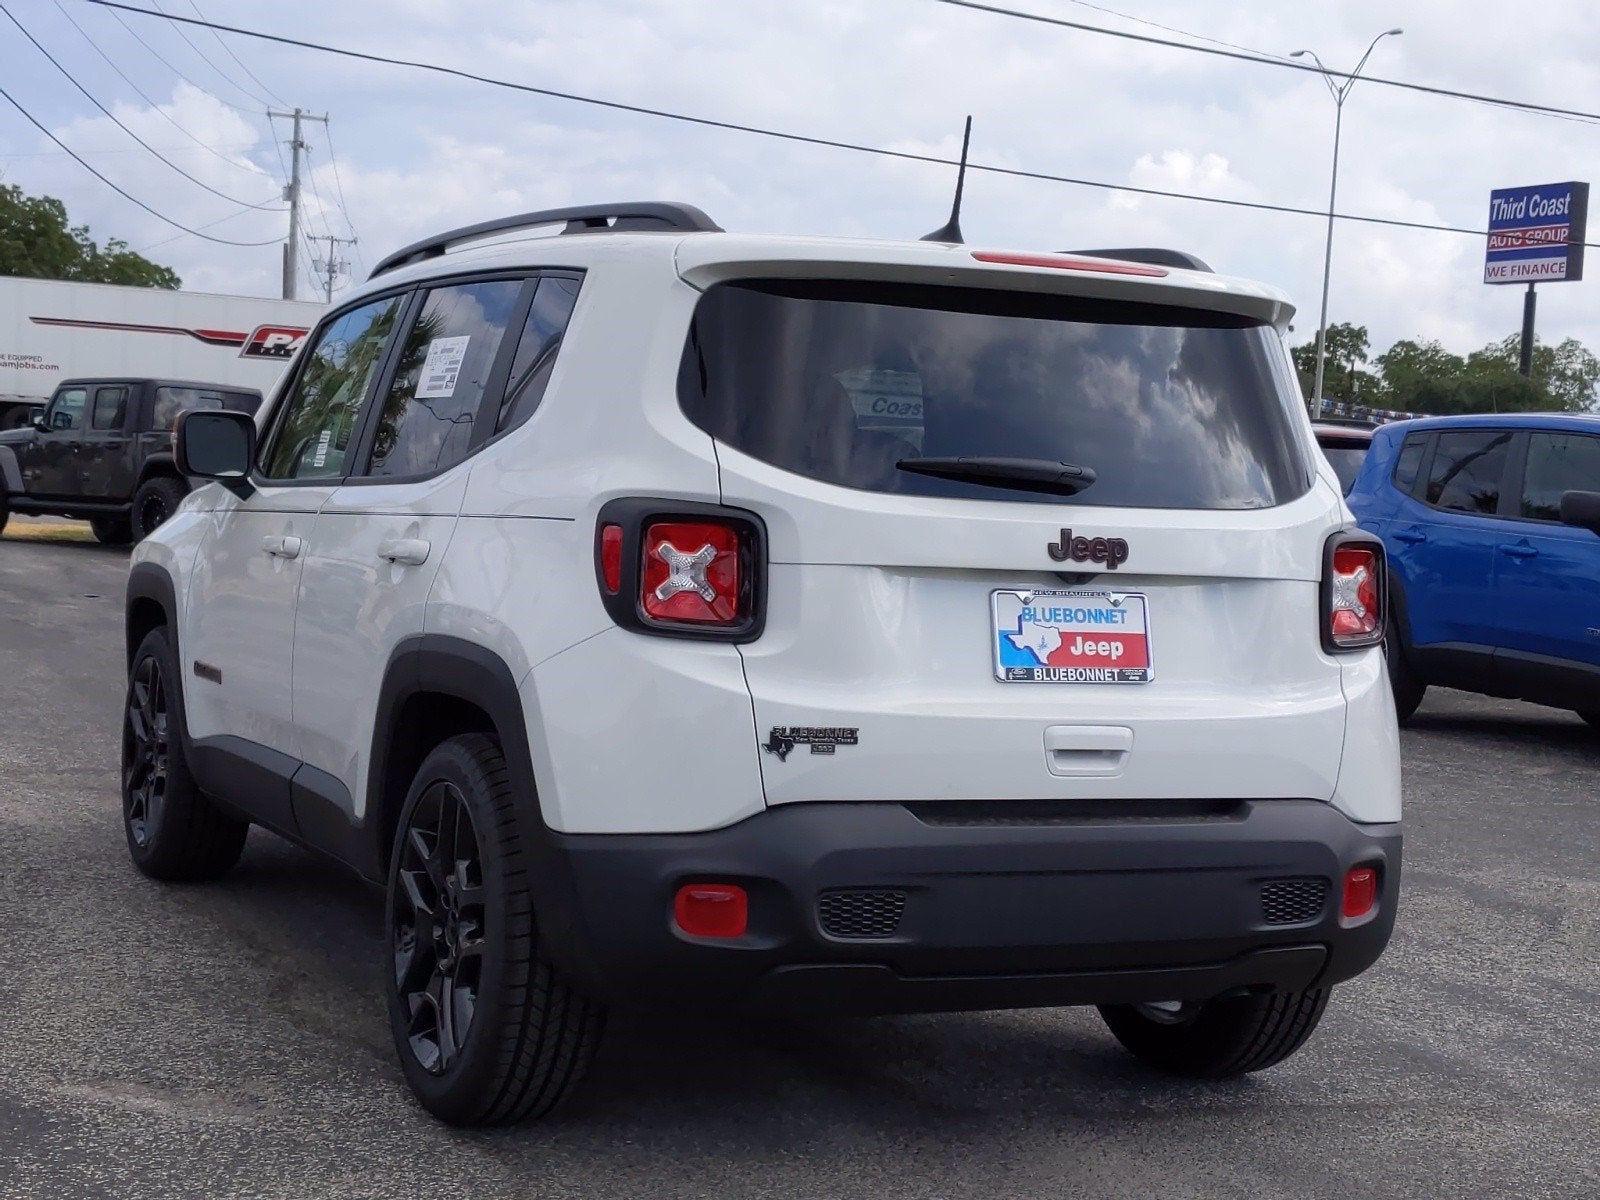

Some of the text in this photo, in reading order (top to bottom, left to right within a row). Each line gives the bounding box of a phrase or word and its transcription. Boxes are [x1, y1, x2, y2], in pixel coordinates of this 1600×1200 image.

[1491, 193, 1572, 221] Third Coast
[1488, 228, 1569, 248] AUTO GROUP
[1487, 261, 1566, 278] WE FINANCE
[1047, 528, 1130, 570] Jeep
[1021, 606, 1128, 625] BLUEBONNET
[1070, 636, 1124, 660] Jeep
[1033, 668, 1120, 682] BLUEBONNET
[772, 726, 859, 737] BLUEBONNET
